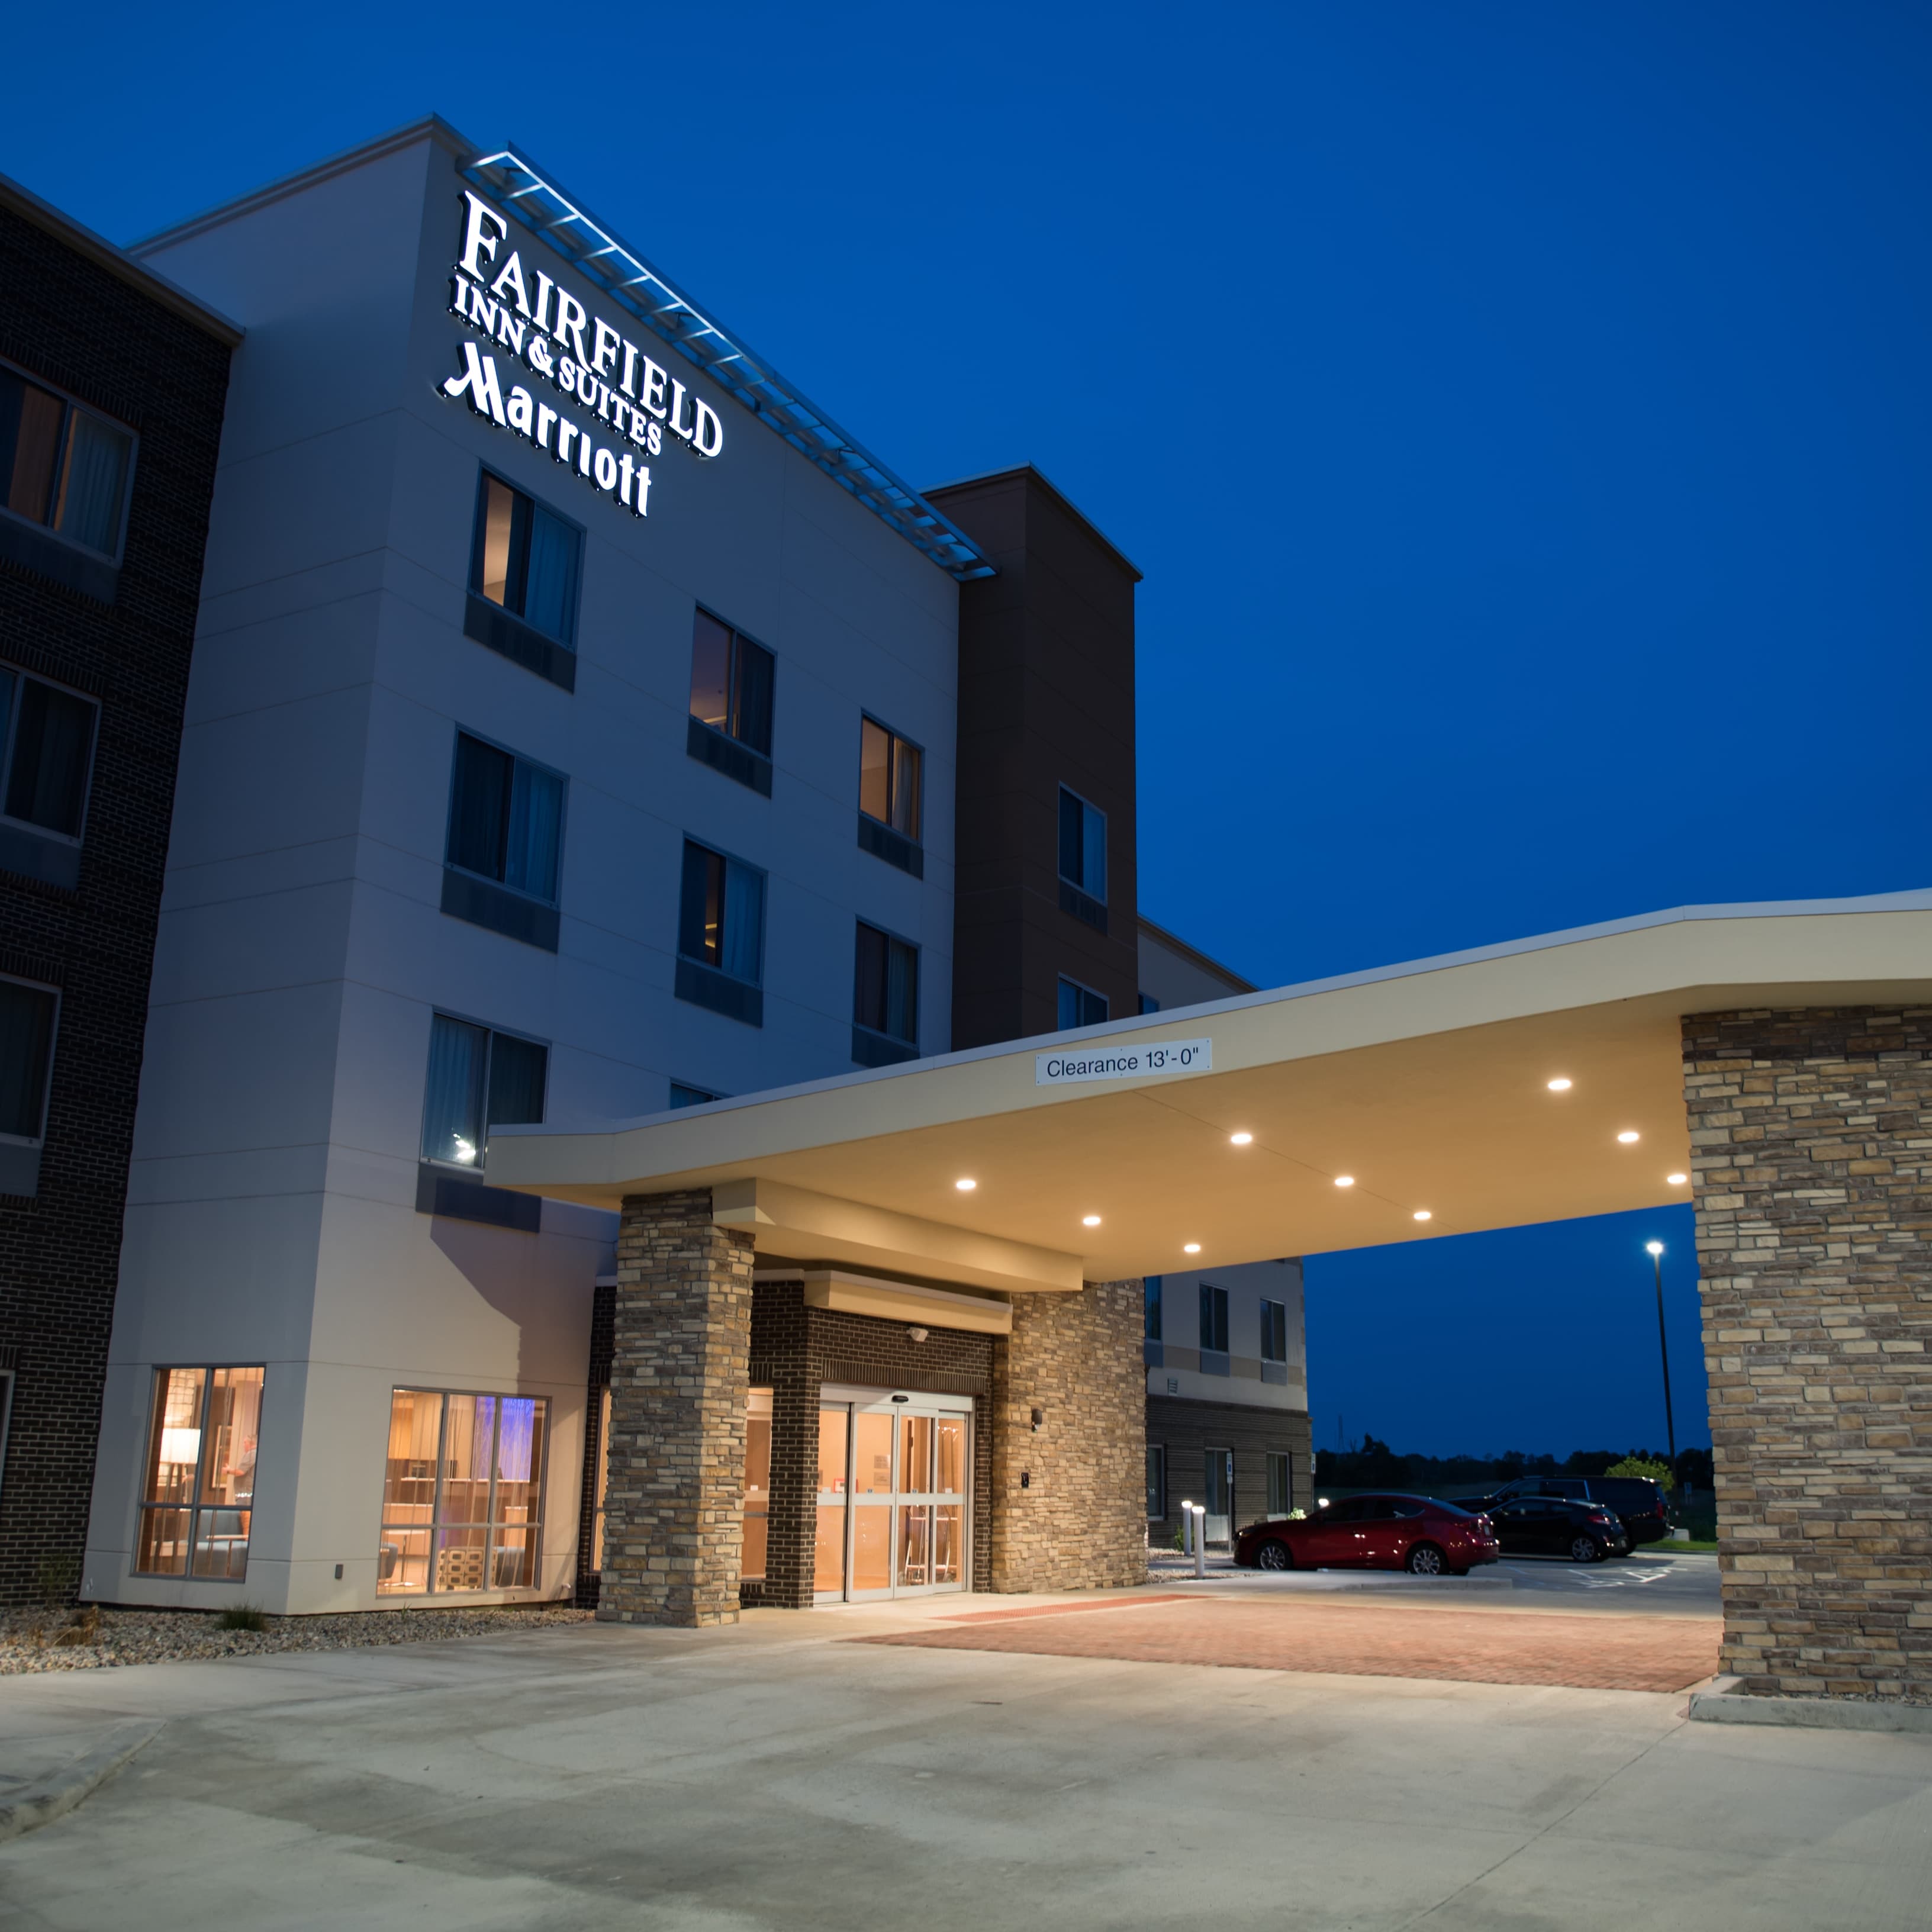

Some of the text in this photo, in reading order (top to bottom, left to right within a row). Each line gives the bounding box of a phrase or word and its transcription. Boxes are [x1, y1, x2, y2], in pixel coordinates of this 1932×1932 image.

[455, 275, 662, 456] INN & SUITES
[459, 190, 723, 457] FAIRFIELD
[444, 342, 652, 517] Marriott
[1047, 1057, 1138, 1077] Clearance
